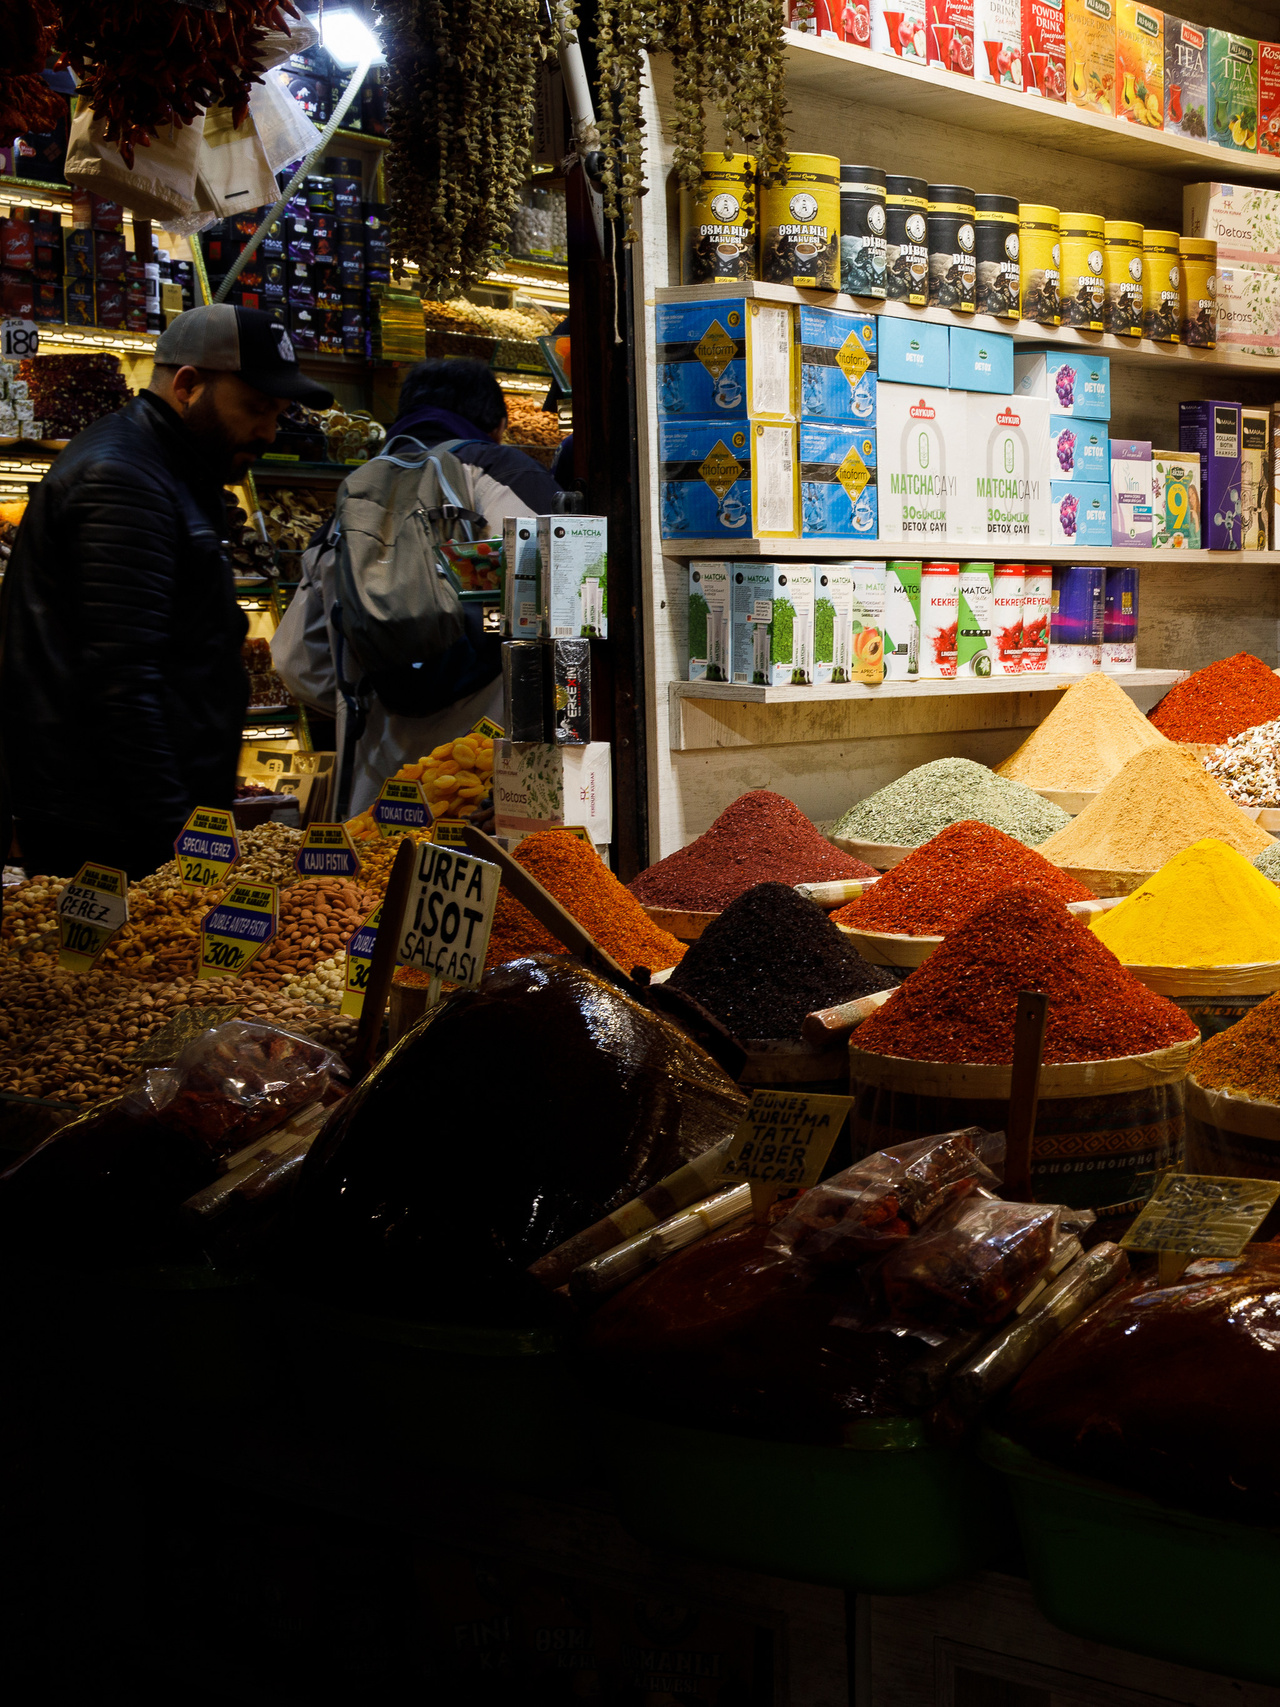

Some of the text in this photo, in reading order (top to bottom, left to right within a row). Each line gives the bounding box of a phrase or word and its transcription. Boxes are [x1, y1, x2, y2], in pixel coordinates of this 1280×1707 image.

[1032, 4, 1064, 22] POWDER
[1036, 16, 1061, 33] DRINK
[1175, 43, 1204, 73] TEA
[1221, 57, 1254, 84] TEA
[1218, 224, 1252, 240] Detoxs
[1219, 308, 1252, 323] Detoxs
[6, 330, 38, 355] 180
[698, 344, 734, 356] fitoform
[838, 352, 869, 366] fitoform
[905, 352, 924, 363] DETOX
[975, 362, 992, 372] DETOX
[1084, 382, 1105, 393] DETOX
[910, 408, 935, 418] ÇAYKUR
[997, 415, 1020, 425] ÇAYKUR
[1083, 446, 1104, 457] DETOX
[702, 463, 739, 476] fitoform
[838, 468, 868, 481] fitoform
[1167, 483, 1189, 529] 9
[1086, 509, 1106, 521] DETOX
[902, 522, 947, 536] DETOX ÇAYI
[987, 524, 1030, 538] DETOX ÇAYI
[704, 574, 726, 582] MATCHA
[747, 575, 770, 583] MATCHA
[791, 576, 812, 584] MATCHA
[500, 787, 528, 804] Detoxs
[380, 806, 424, 824] TOKAT CEVİZ
[183, 836, 231, 860] SPECIAL ÇEREZ
[304, 853, 349, 871] KAJU FISTIK
[418, 846, 482, 902] URFA
[60, 899, 110, 923] ÇEREZ
[209, 916, 269, 938] DUBLE ANTEP FISTIK
[400, 931, 476, 984] SALÇASI
